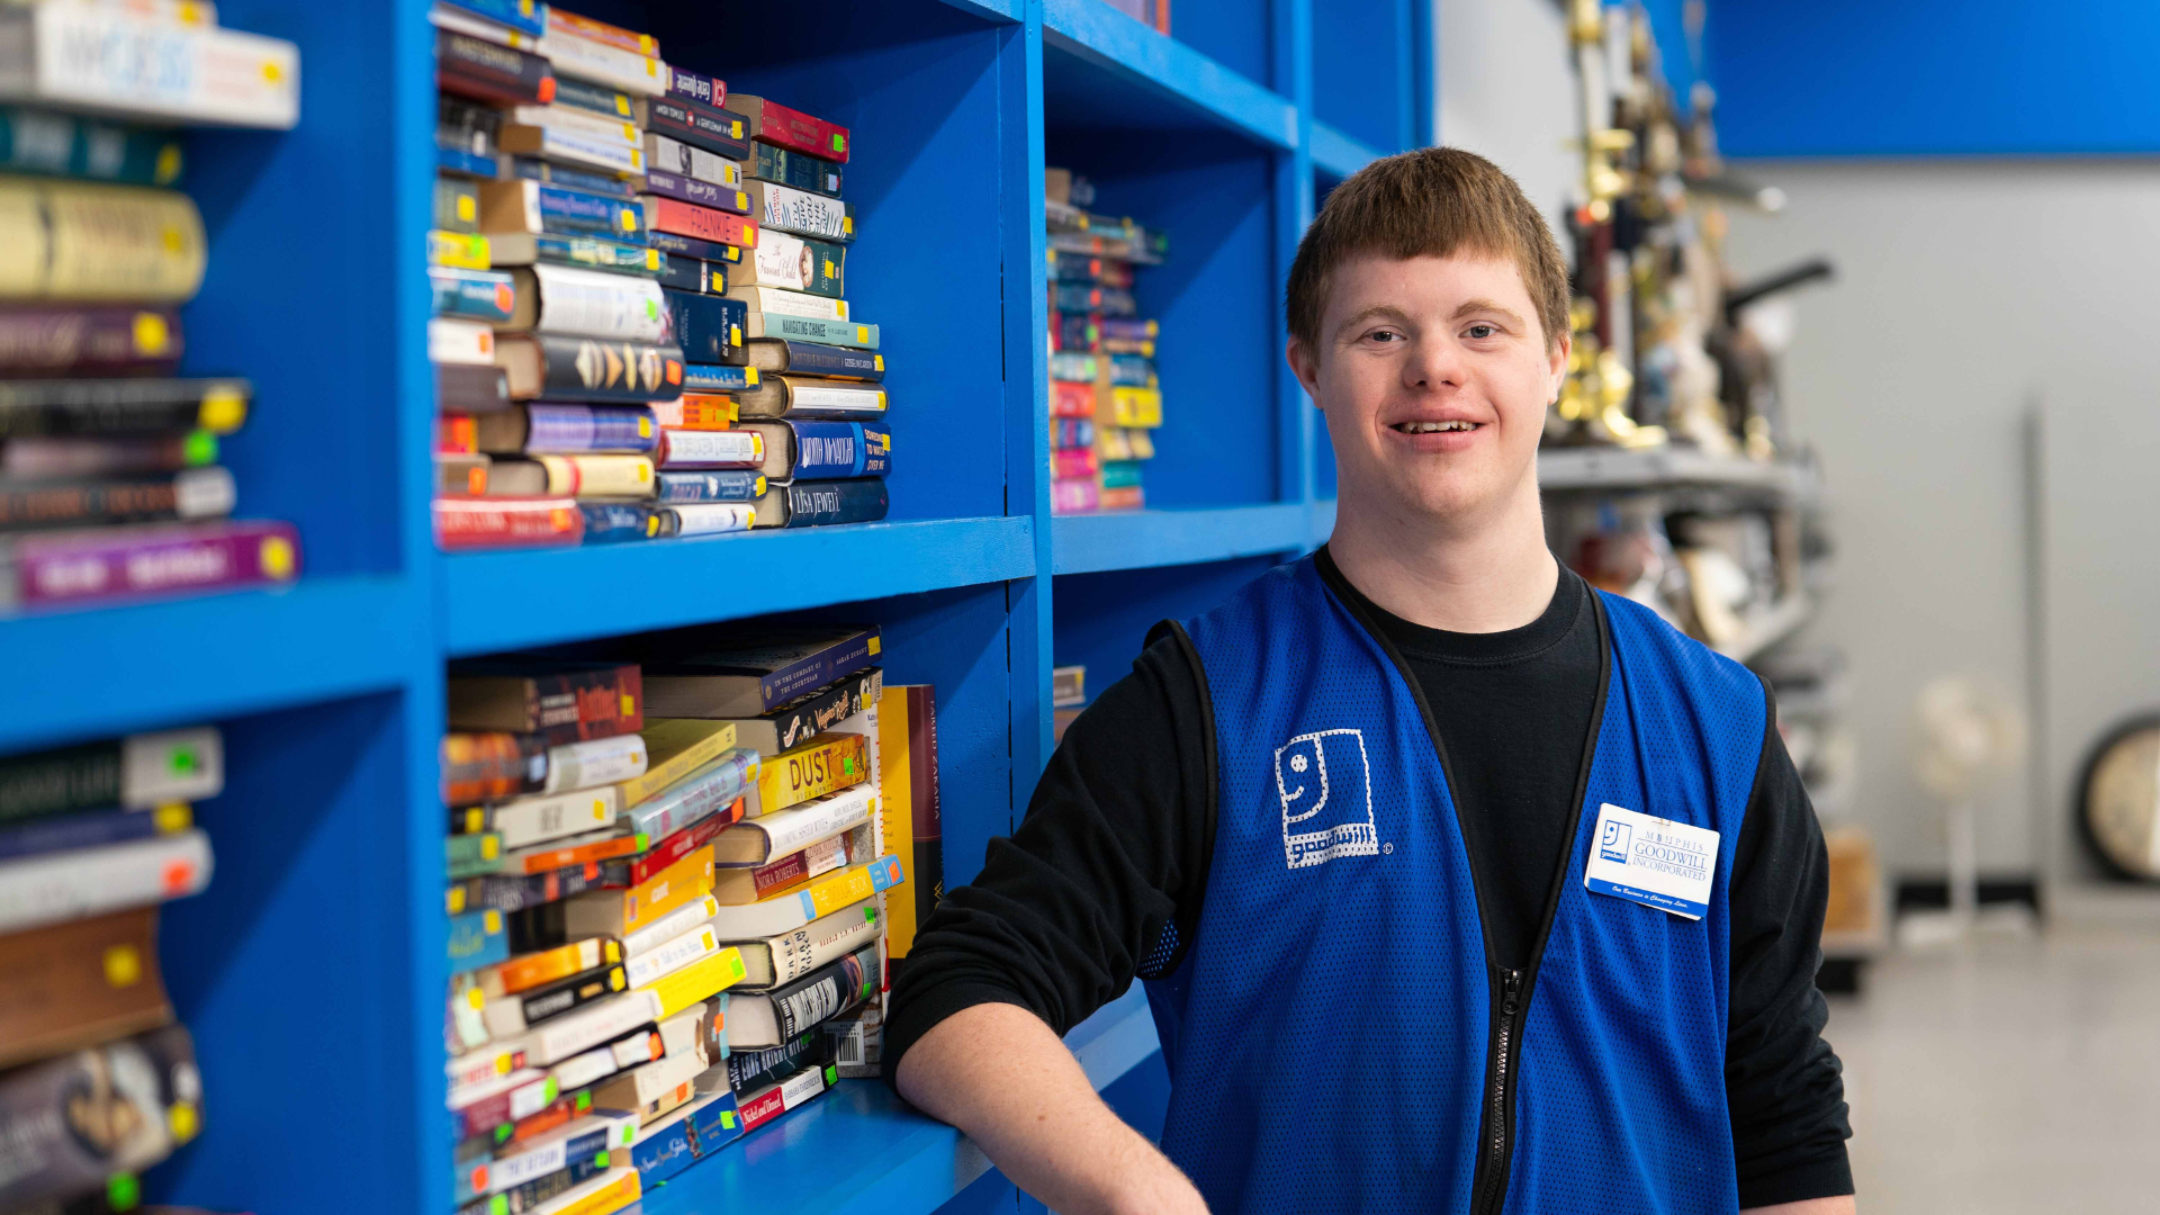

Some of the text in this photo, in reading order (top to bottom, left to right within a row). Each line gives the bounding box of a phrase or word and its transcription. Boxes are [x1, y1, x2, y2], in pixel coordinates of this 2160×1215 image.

[691, 208, 731, 242] FRANKIE
[782, 319, 808, 336] NAVIGATING
[808, 322, 826, 338] CHANGE
[795, 488, 812, 514] LISA
[780, 674, 818, 696] THE COURTESAN
[782, 674, 792, 684] THE
[793, 664, 814, 680] COMPANY
[789, 748, 832, 791] DUST
[930, 700, 940, 820] FAREED ZAKARIA
[1292, 825, 1372, 863] goodwill
[1602, 852, 1626, 861] goodwill
[1635, 842, 1708, 870] GOODWILL
[756, 869, 775, 890] NORA
[776, 861, 800, 884] ROBERTS
[1632, 856, 1706, 882] INCORPORATED
[849, 876, 868, 897] BOOK
[1612, 885, 1622, 893] Our
[1623, 888, 1643, 898] Business
[1650, 895, 1673, 906] Changing
[784, 937, 794, 979] DARK
[740, 1055, 760, 1081] LONG
[788, 1036, 810, 1057] RIV
[743, 1094, 782, 1125] Nickel and Dimed
